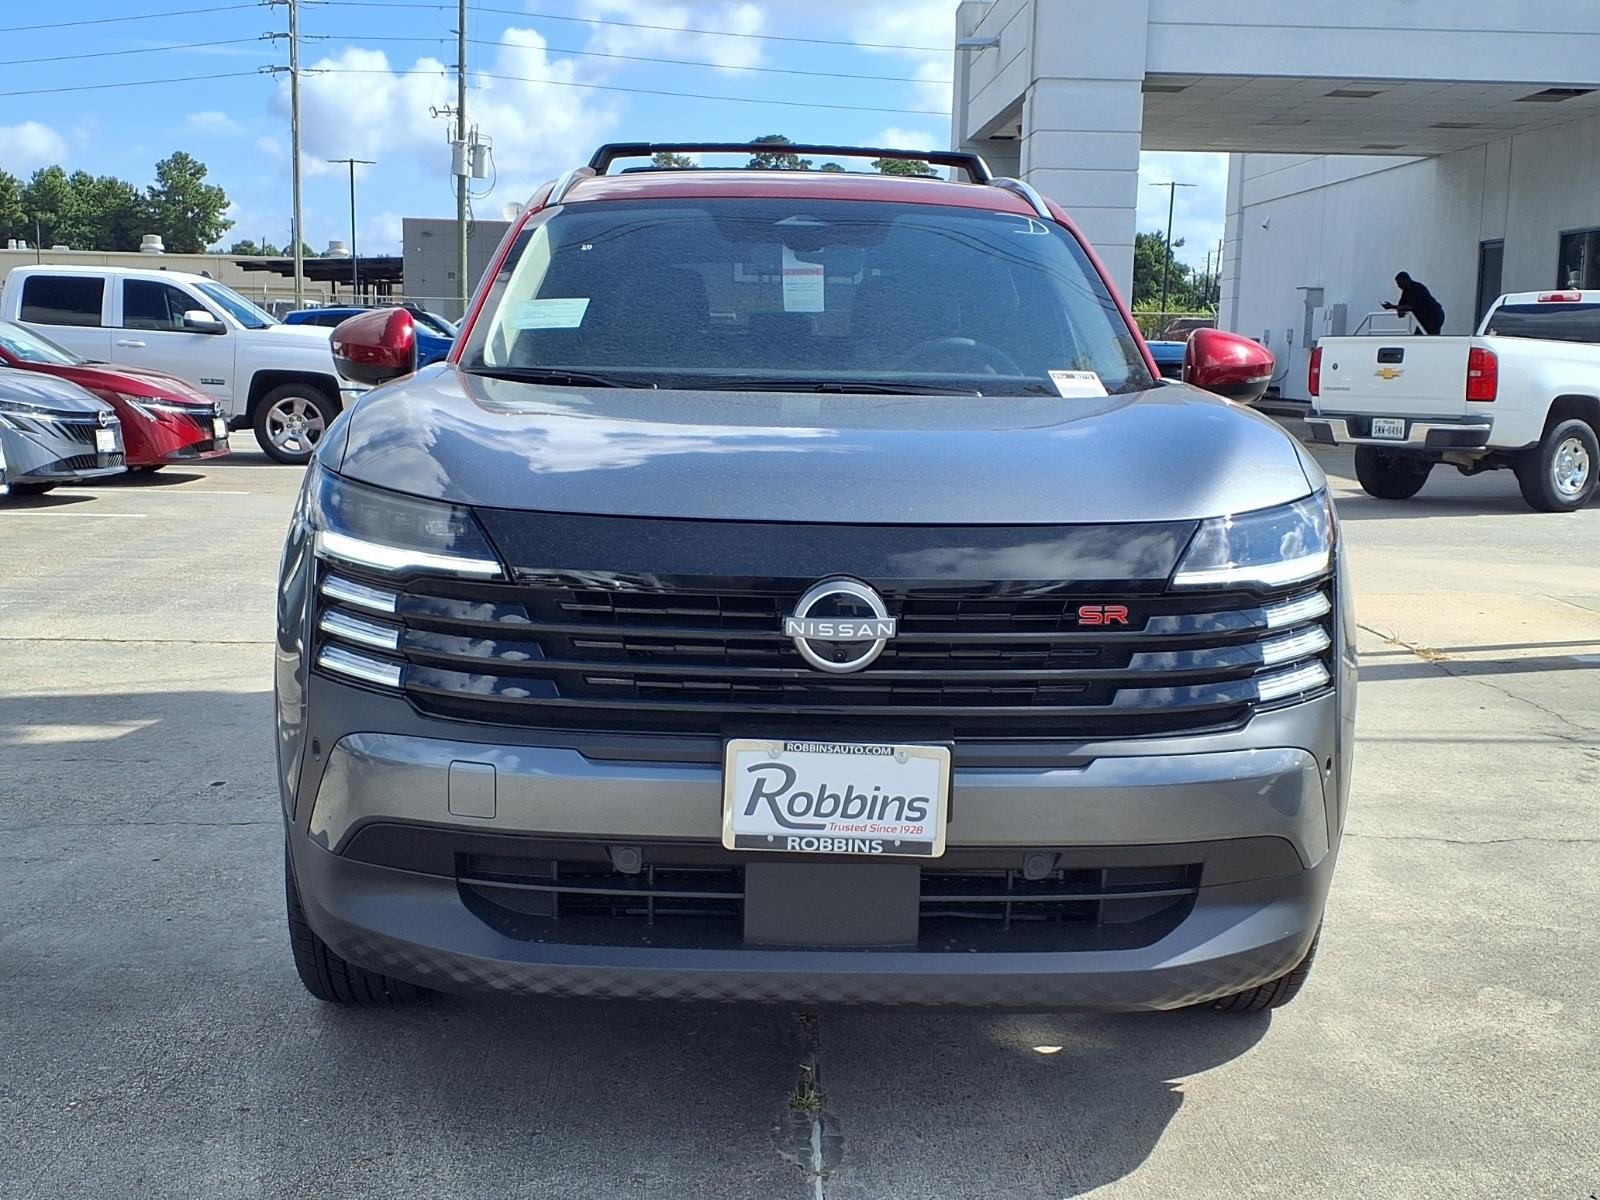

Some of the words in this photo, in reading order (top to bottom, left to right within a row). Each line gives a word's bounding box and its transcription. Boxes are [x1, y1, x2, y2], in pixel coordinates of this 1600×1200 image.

[1078, 605, 1129, 625] SR
[788, 620, 893, 637] NISSAN
[786, 742, 892, 756] ROBBINSAUTO.COM
[743, 762, 930, 831] Robbins
[829, 822, 868, 833] Trusted
[869, 823, 898, 834] Since
[899, 825, 924, 835] 1928
[786, 836, 883, 854] ROBBINS
